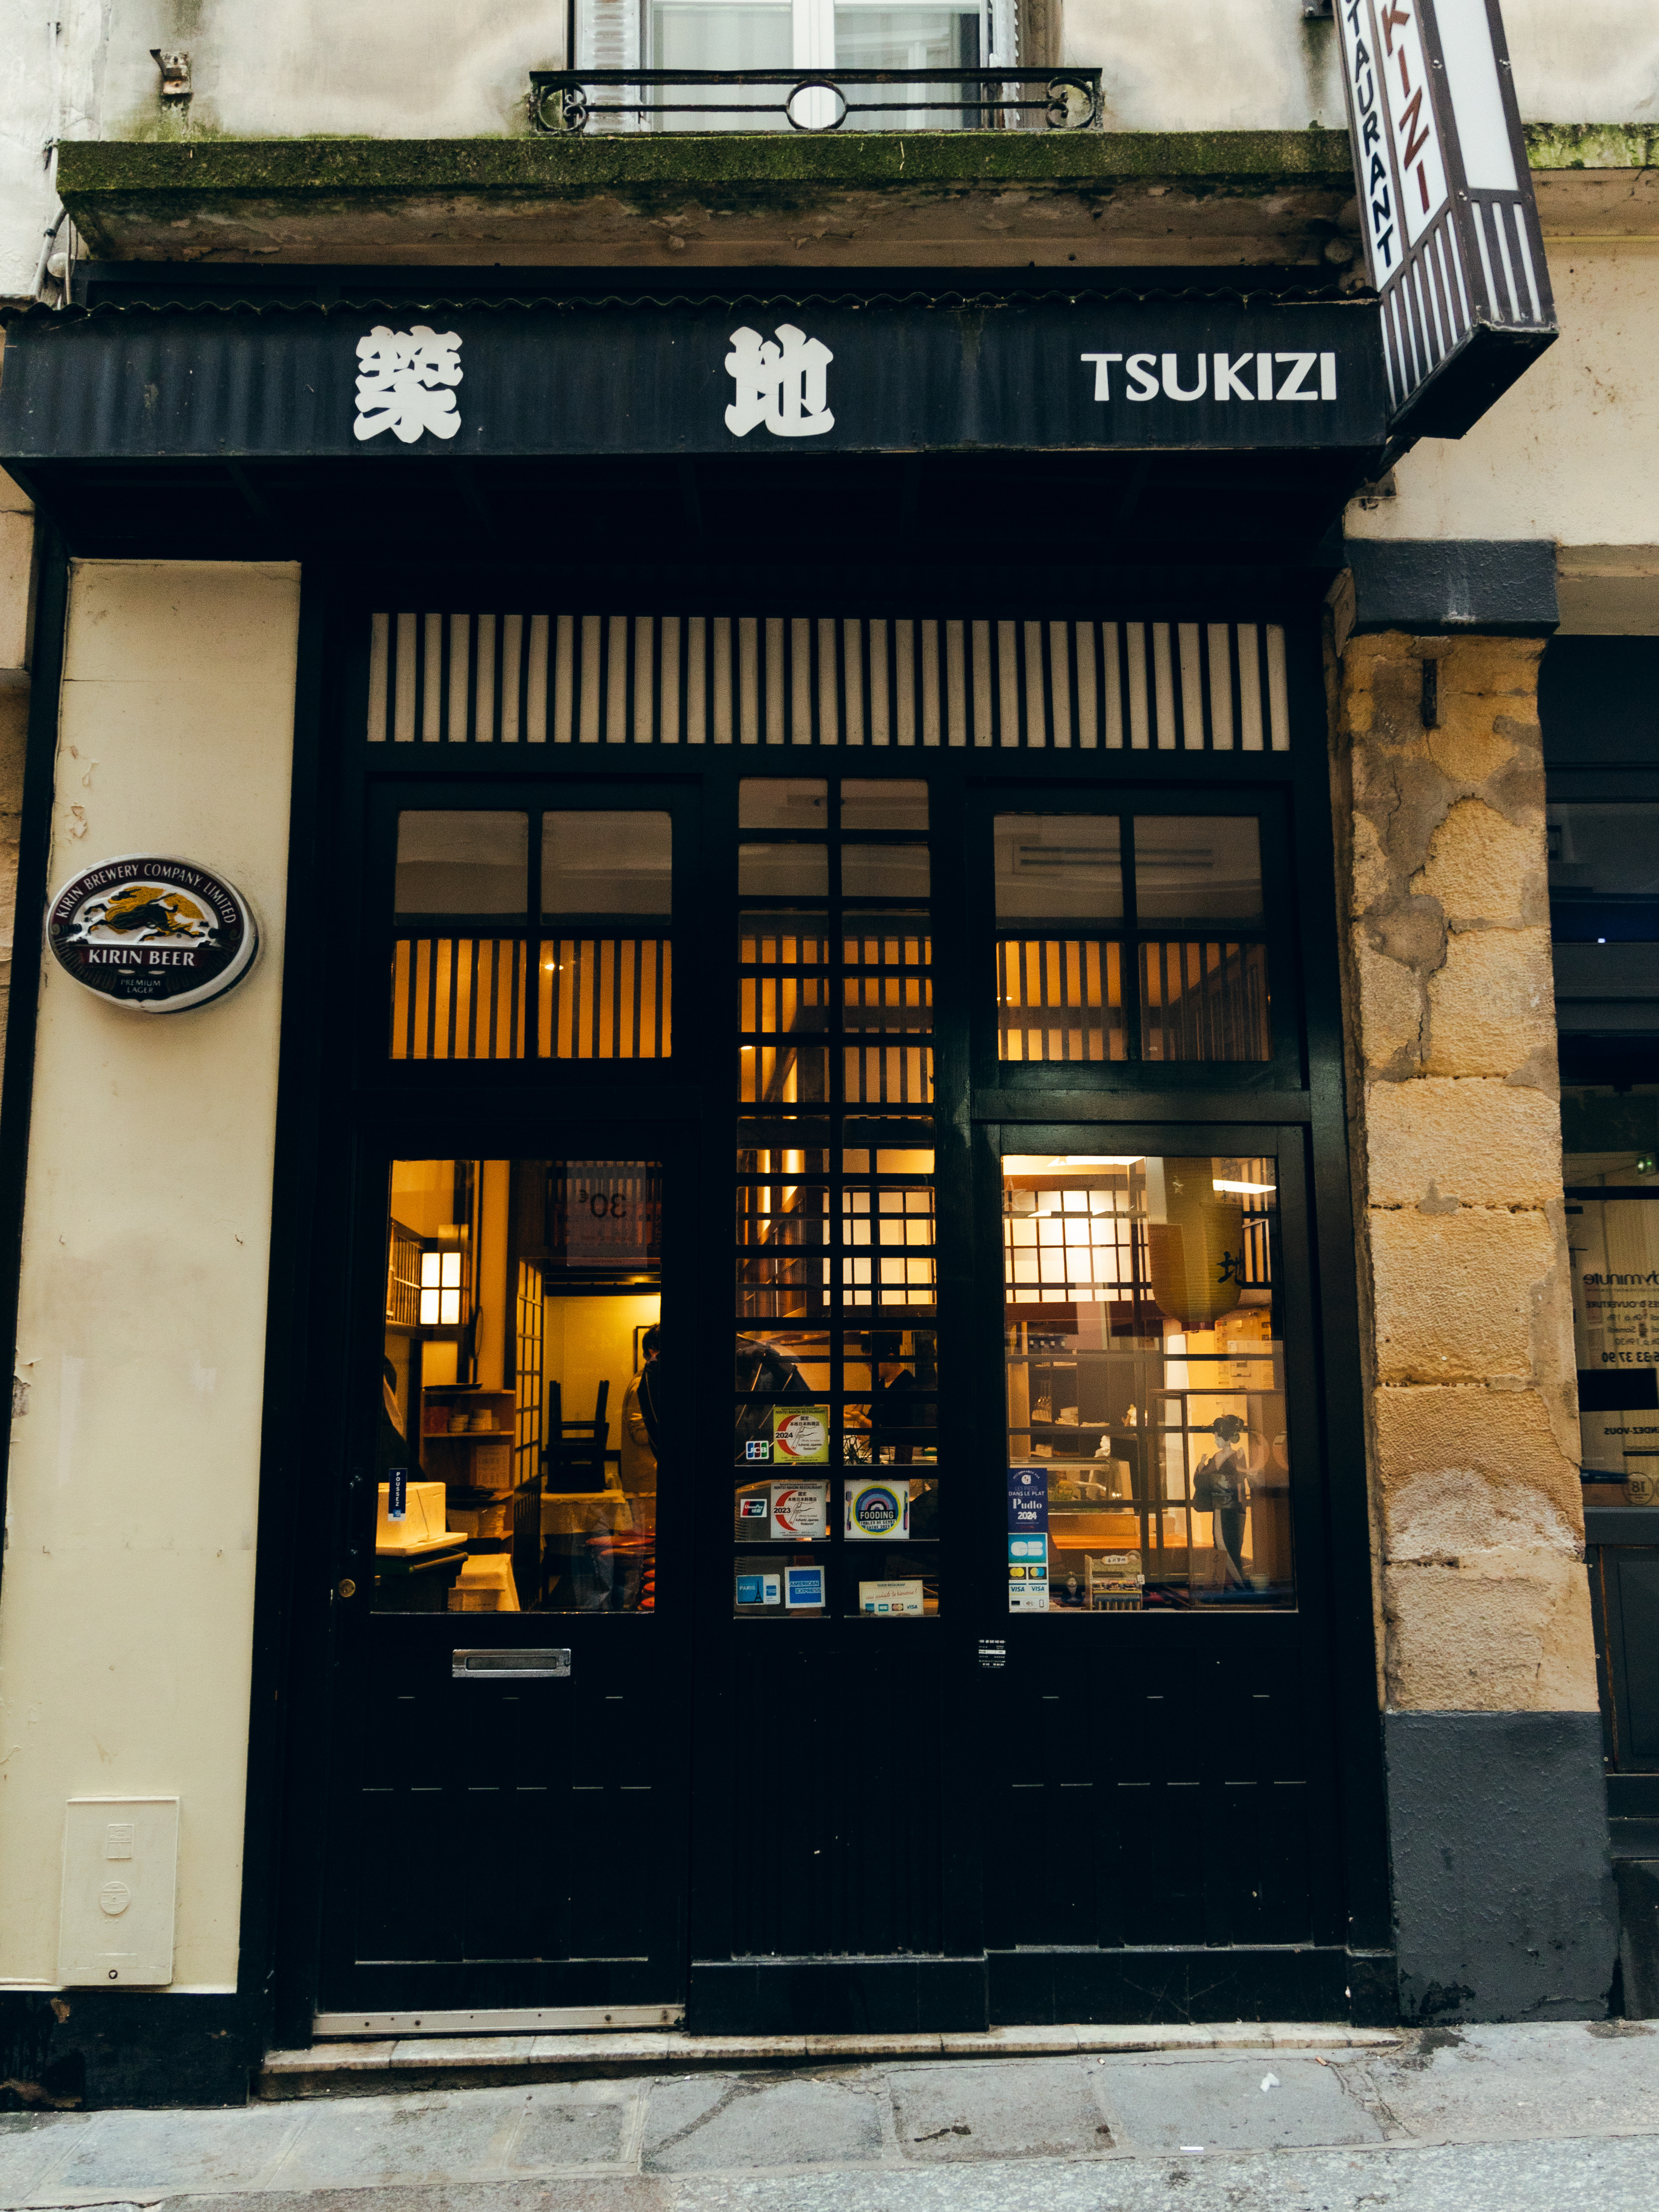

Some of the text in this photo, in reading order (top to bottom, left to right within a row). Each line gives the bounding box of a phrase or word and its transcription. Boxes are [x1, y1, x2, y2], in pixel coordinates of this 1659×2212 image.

[1345, 0, 1393, 267] TAURANT
[1081, 352, 1337, 402] TSUKIZI
[55, 864, 236, 923] KIRIN BREWERY COMPANY, LIMITED
[88, 949, 195, 966] KIRIN BEER
[1013, 1498, 1042, 1509] Pudlo
[860, 1511, 894, 1519] FOODING
[1017, 1512, 1037, 1520] 2024
[1011, 1541, 1043, 1556] CB
